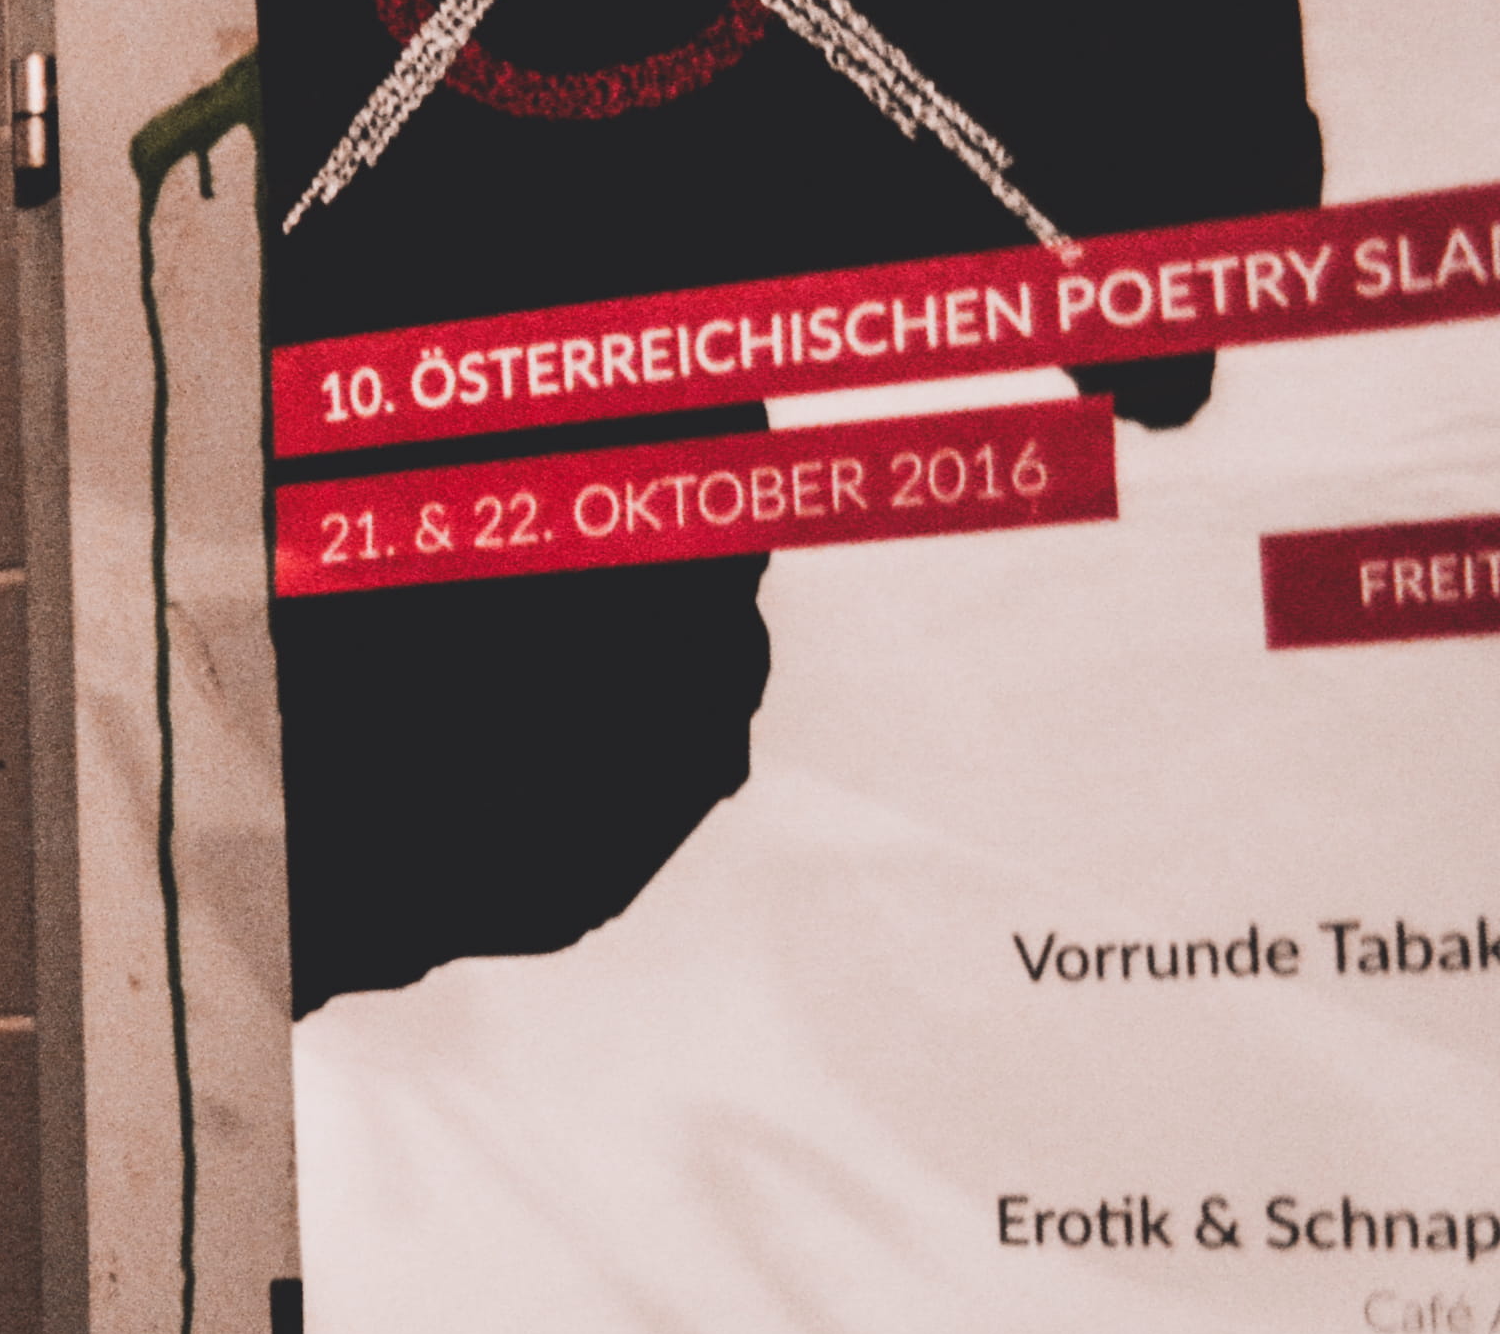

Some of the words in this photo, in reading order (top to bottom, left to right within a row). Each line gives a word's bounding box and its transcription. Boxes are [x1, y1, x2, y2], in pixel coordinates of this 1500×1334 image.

[322, 362, 395, 424] 10.
[412, 277, 1033, 408] ÖSTERREICHISCHEN
[1055, 245, 1332, 337] POETRY
[1354, 222, 1500, 298] SLA
[322, 506, 395, 566] 21.
[414, 502, 455, 552] &
[472, 490, 552, 550] 22.
[574, 449, 866, 537] OKTOBER
[890, 438, 1048, 506] 2016
[1013, 922, 1299, 983] Vorrunde
[999, 1193, 1172, 1249] Erotik
[1196, 1194, 1241, 1250] &
[1365, 1290, 1472, 1333] Café
